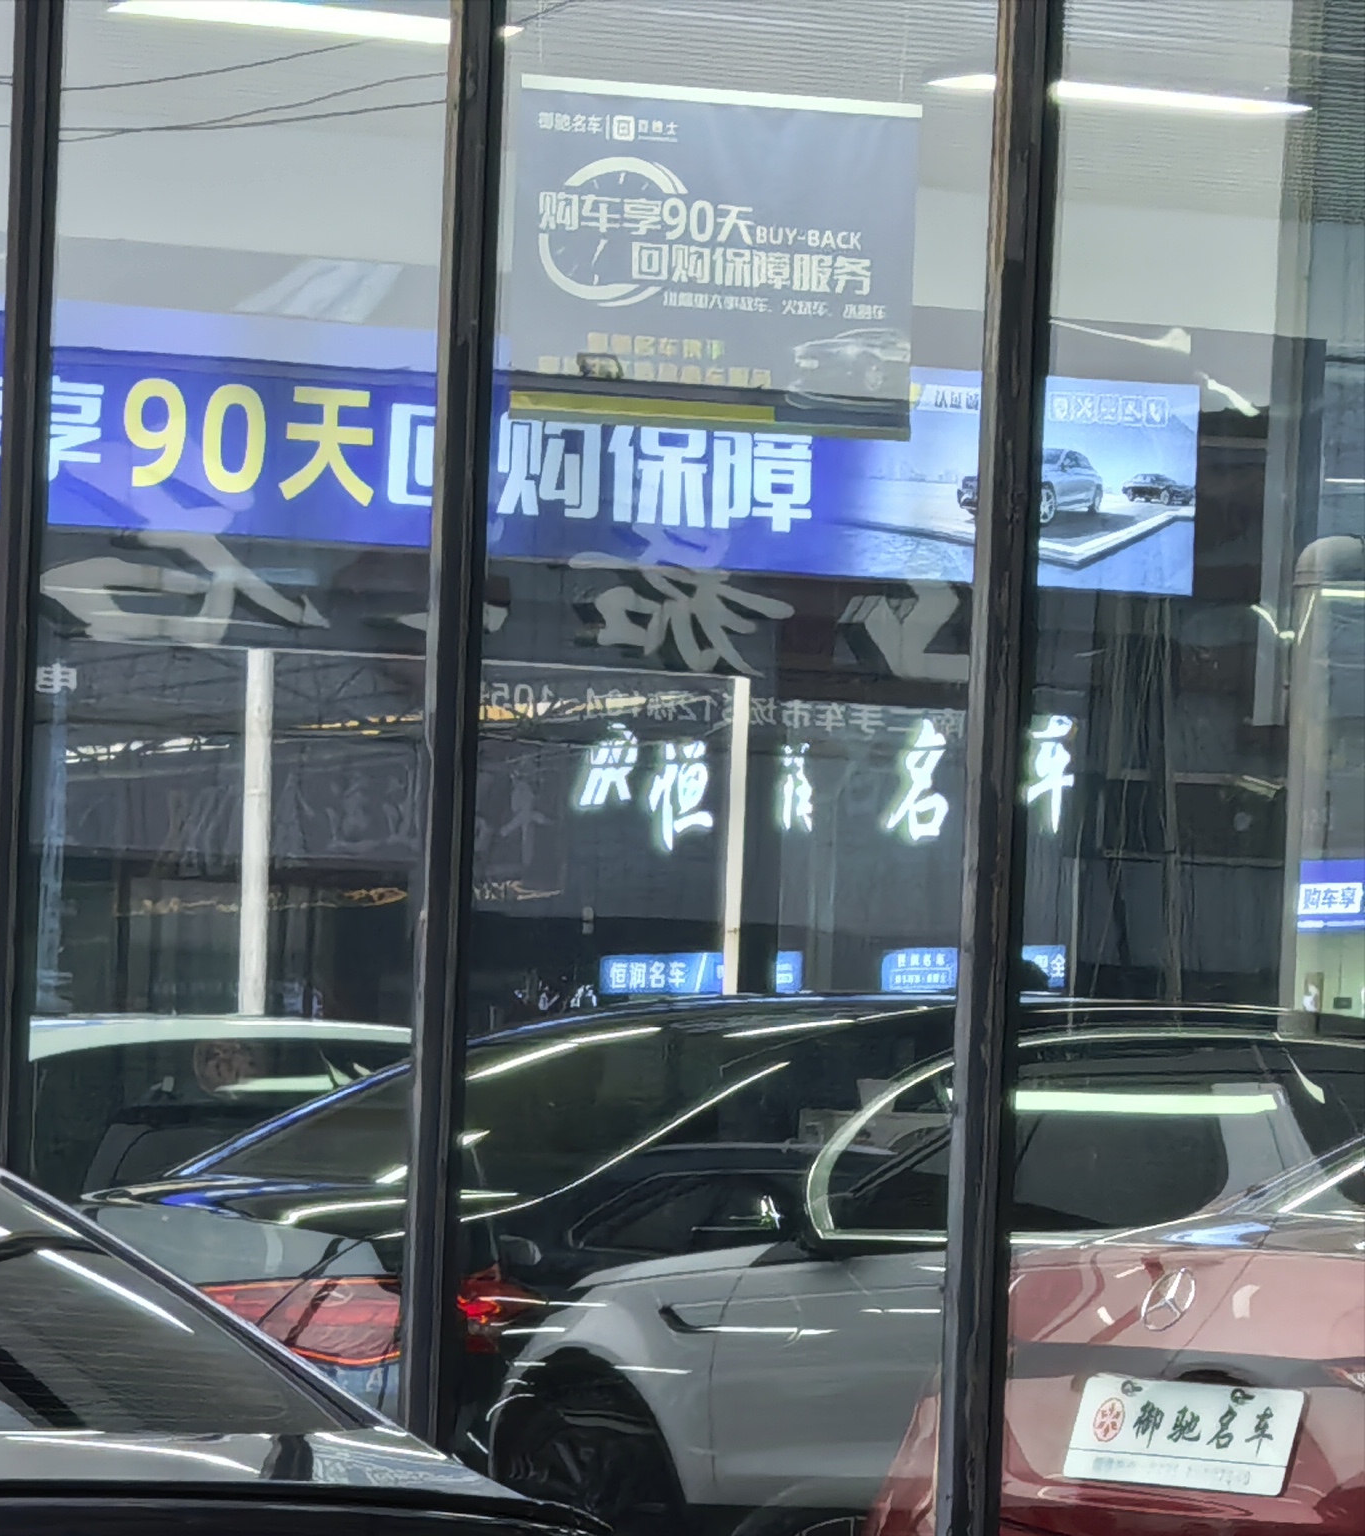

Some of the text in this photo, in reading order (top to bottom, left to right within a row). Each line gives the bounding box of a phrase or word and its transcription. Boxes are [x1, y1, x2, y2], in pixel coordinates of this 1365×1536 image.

[537, 189, 863, 251] 购车享90天 BUY-BACK
[631, 241, 873, 296] 回购保障服务
[609, 961, 687, 989] 恒润名车
[1132, 1399, 1275, 1457] 御驰名车
